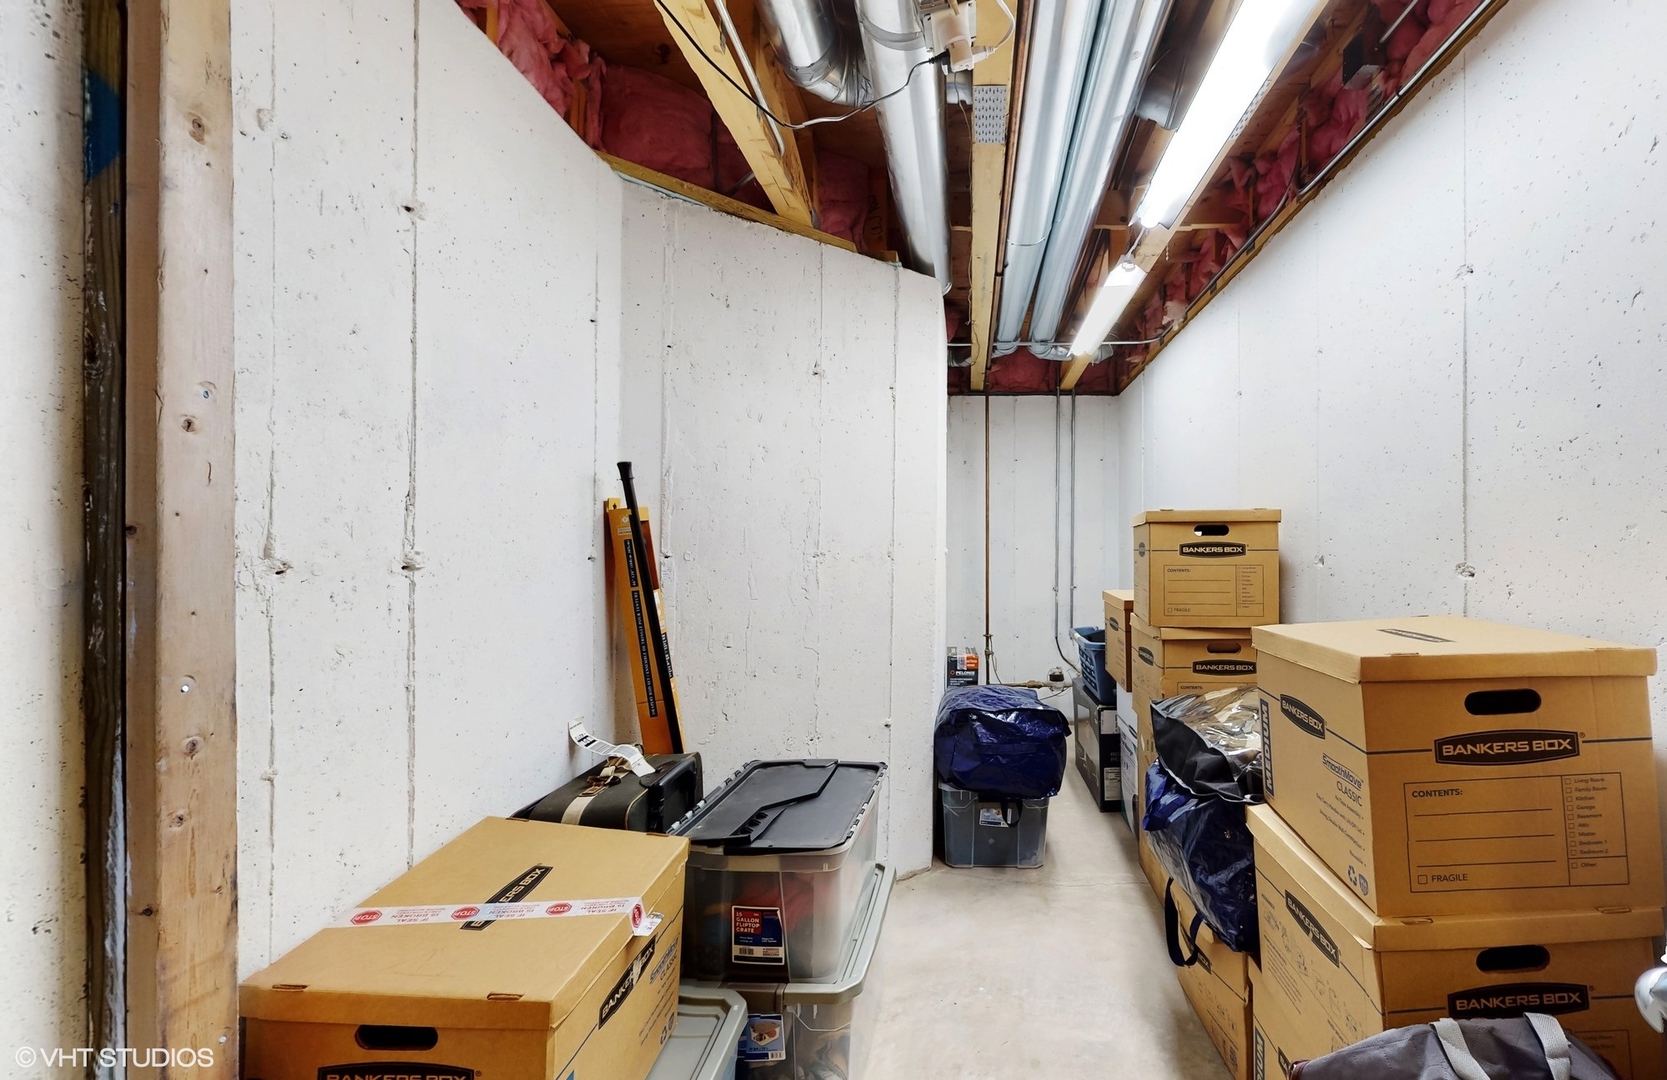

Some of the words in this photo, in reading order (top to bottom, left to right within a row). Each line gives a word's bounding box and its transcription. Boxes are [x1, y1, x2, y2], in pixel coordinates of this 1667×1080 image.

[1282, 701, 1308, 723] BANKERS
[1309, 717, 1323, 732] BOX
[1262, 705, 1273, 791] MEDIUM
[1442, 741, 1529, 756] BANKERS
[1532, 739, 1573, 751] BOX
[1322, 755, 1362, 789] SmoothMove
[1337, 781, 1362, 807] CLASSIC
[1412, 789, 1463, 798] CONTENTS:
[519, 868, 545, 886] BOX
[1432, 874, 1468, 882] FRAGILE
[354, 913, 379, 921] STOP
[1287, 897, 1319, 939] BANKERS
[1320, 934, 1336, 959] BOX
[1456, 994, 1540, 1010] BANKERS
[1543, 992, 1582, 1005] BOX
